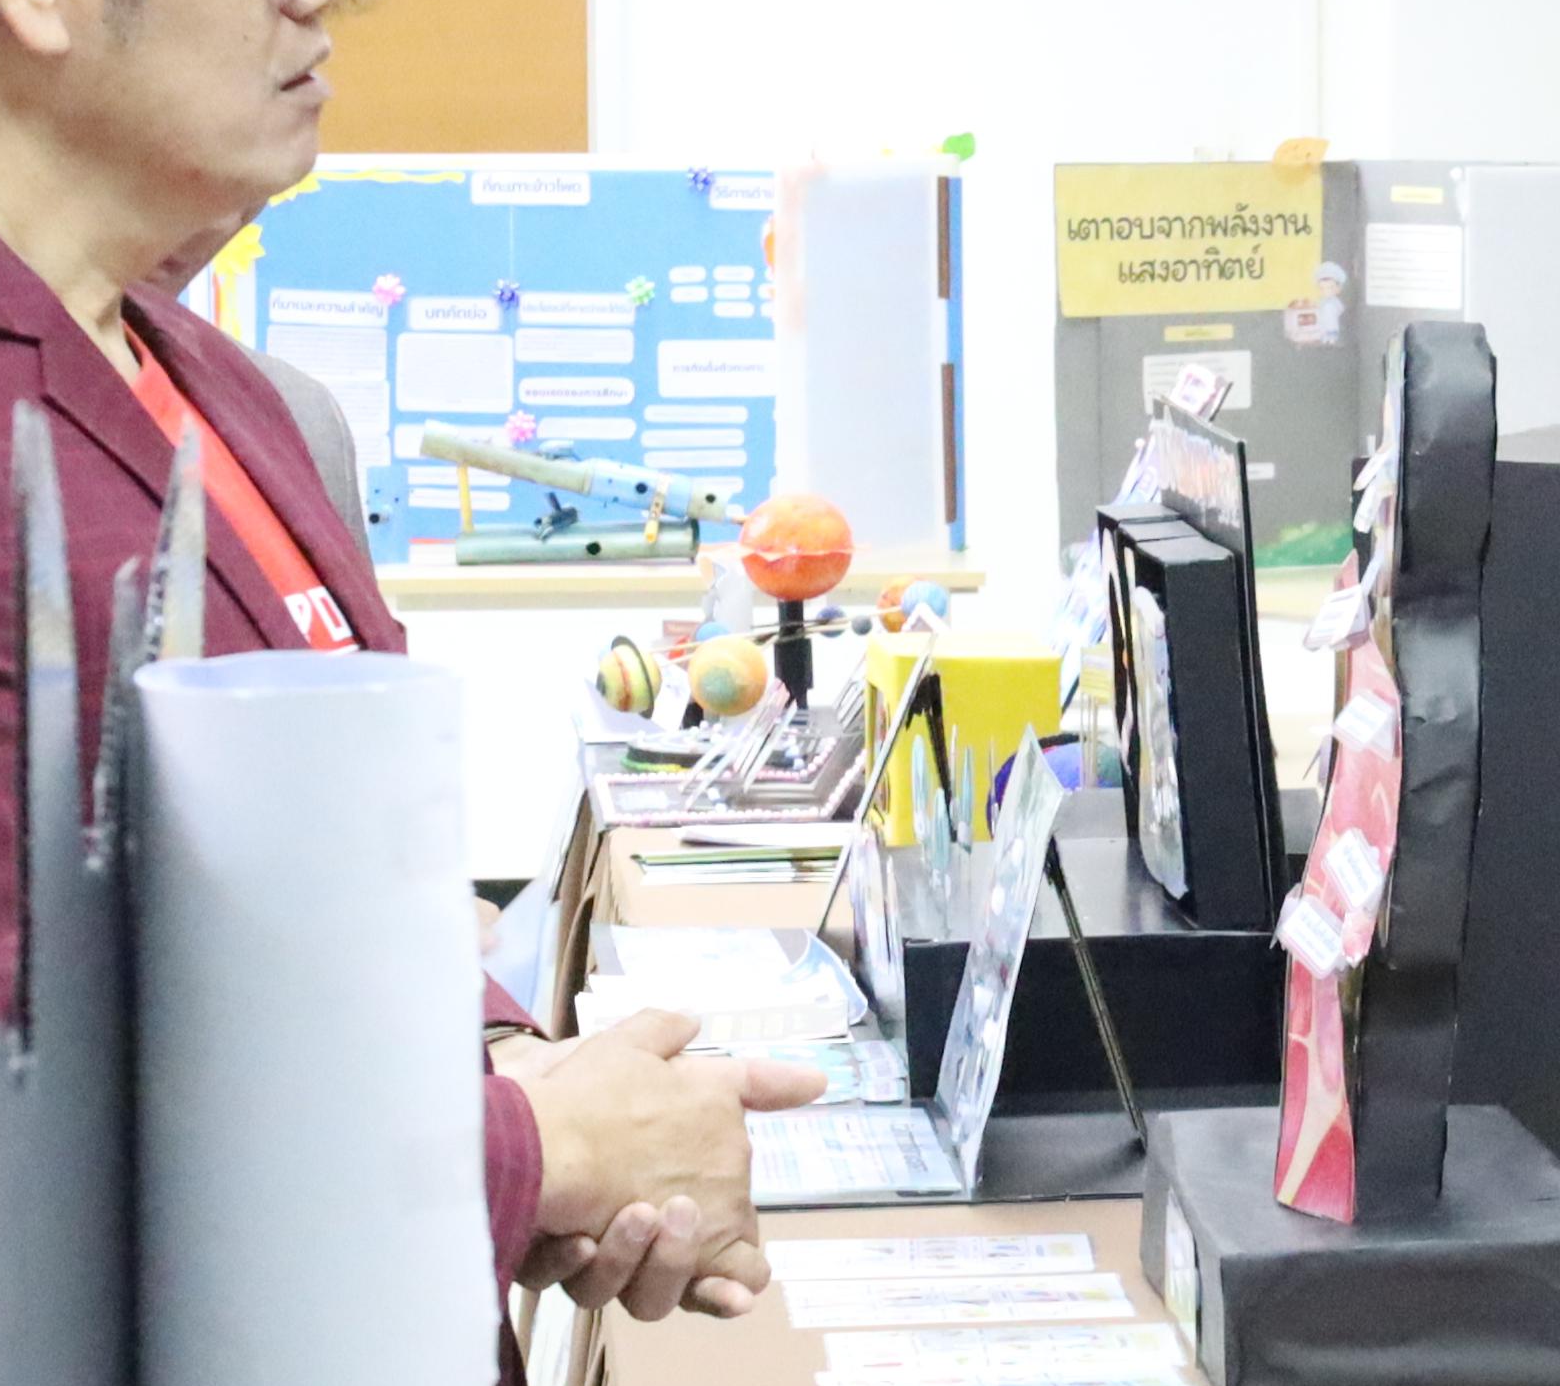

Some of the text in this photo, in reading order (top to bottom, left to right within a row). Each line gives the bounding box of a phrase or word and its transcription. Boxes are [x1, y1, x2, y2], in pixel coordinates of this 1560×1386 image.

[1117, 244, 1265, 284] แสงอาทิตย์
[424, 304, 488, 320] บทคัดย่อ
